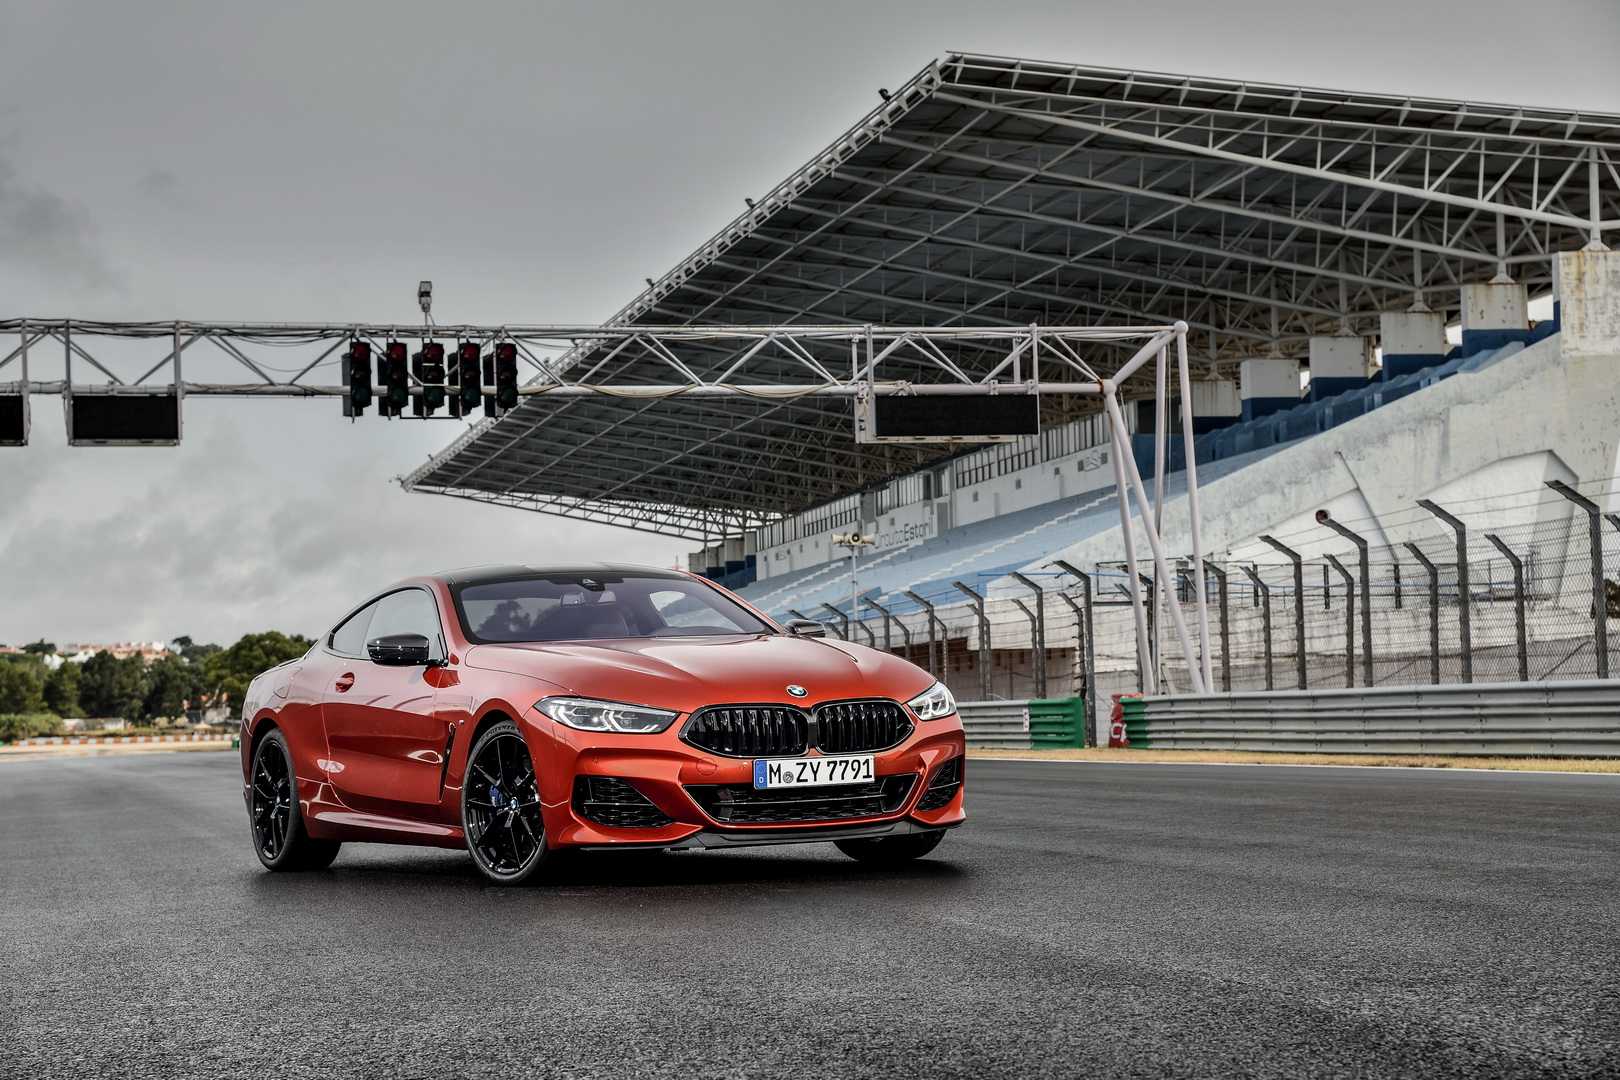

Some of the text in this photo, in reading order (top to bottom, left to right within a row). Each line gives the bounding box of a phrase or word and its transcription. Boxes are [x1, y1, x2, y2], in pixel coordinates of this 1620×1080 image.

[769, 759, 872, 784] M ZY 7791
